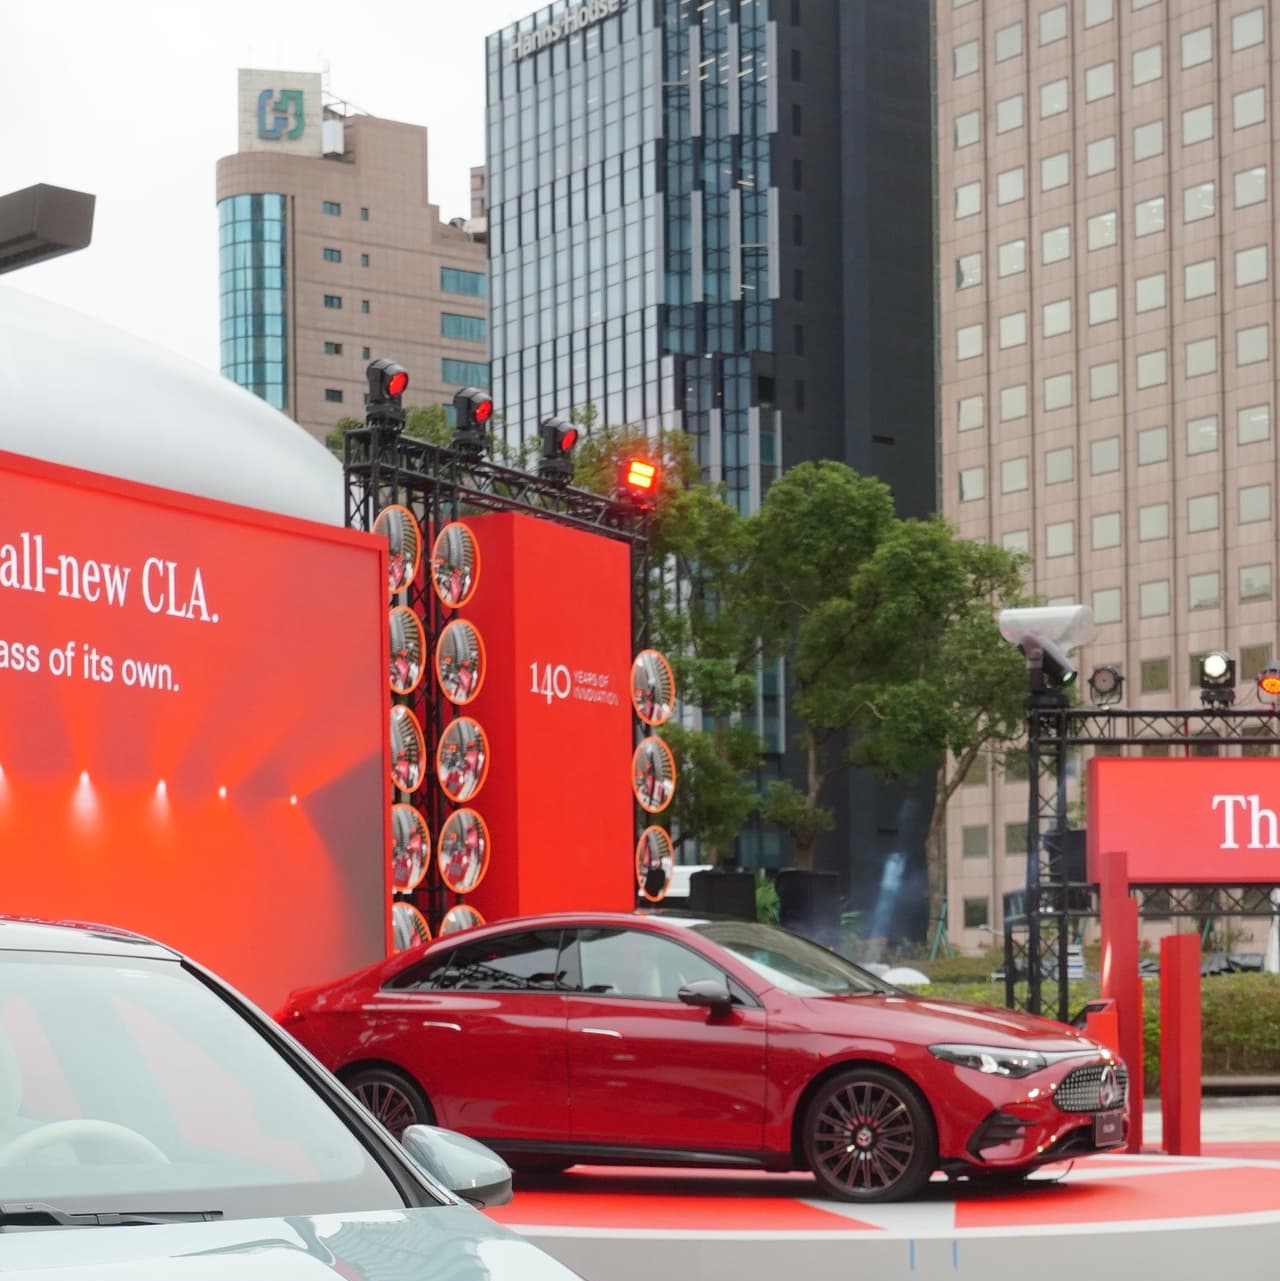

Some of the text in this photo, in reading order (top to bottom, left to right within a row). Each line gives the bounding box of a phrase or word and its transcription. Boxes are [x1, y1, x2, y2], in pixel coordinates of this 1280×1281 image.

[511, 22, 562, 58] Hanns
[0, 532, 131, 607] all-new
[142, 557, 219, 624] CLA.
[48, 641, 77, 677] of
[83, 643, 114, 683] its
[121, 659, 180, 692] own.
[529, 661, 571, 705] 140
